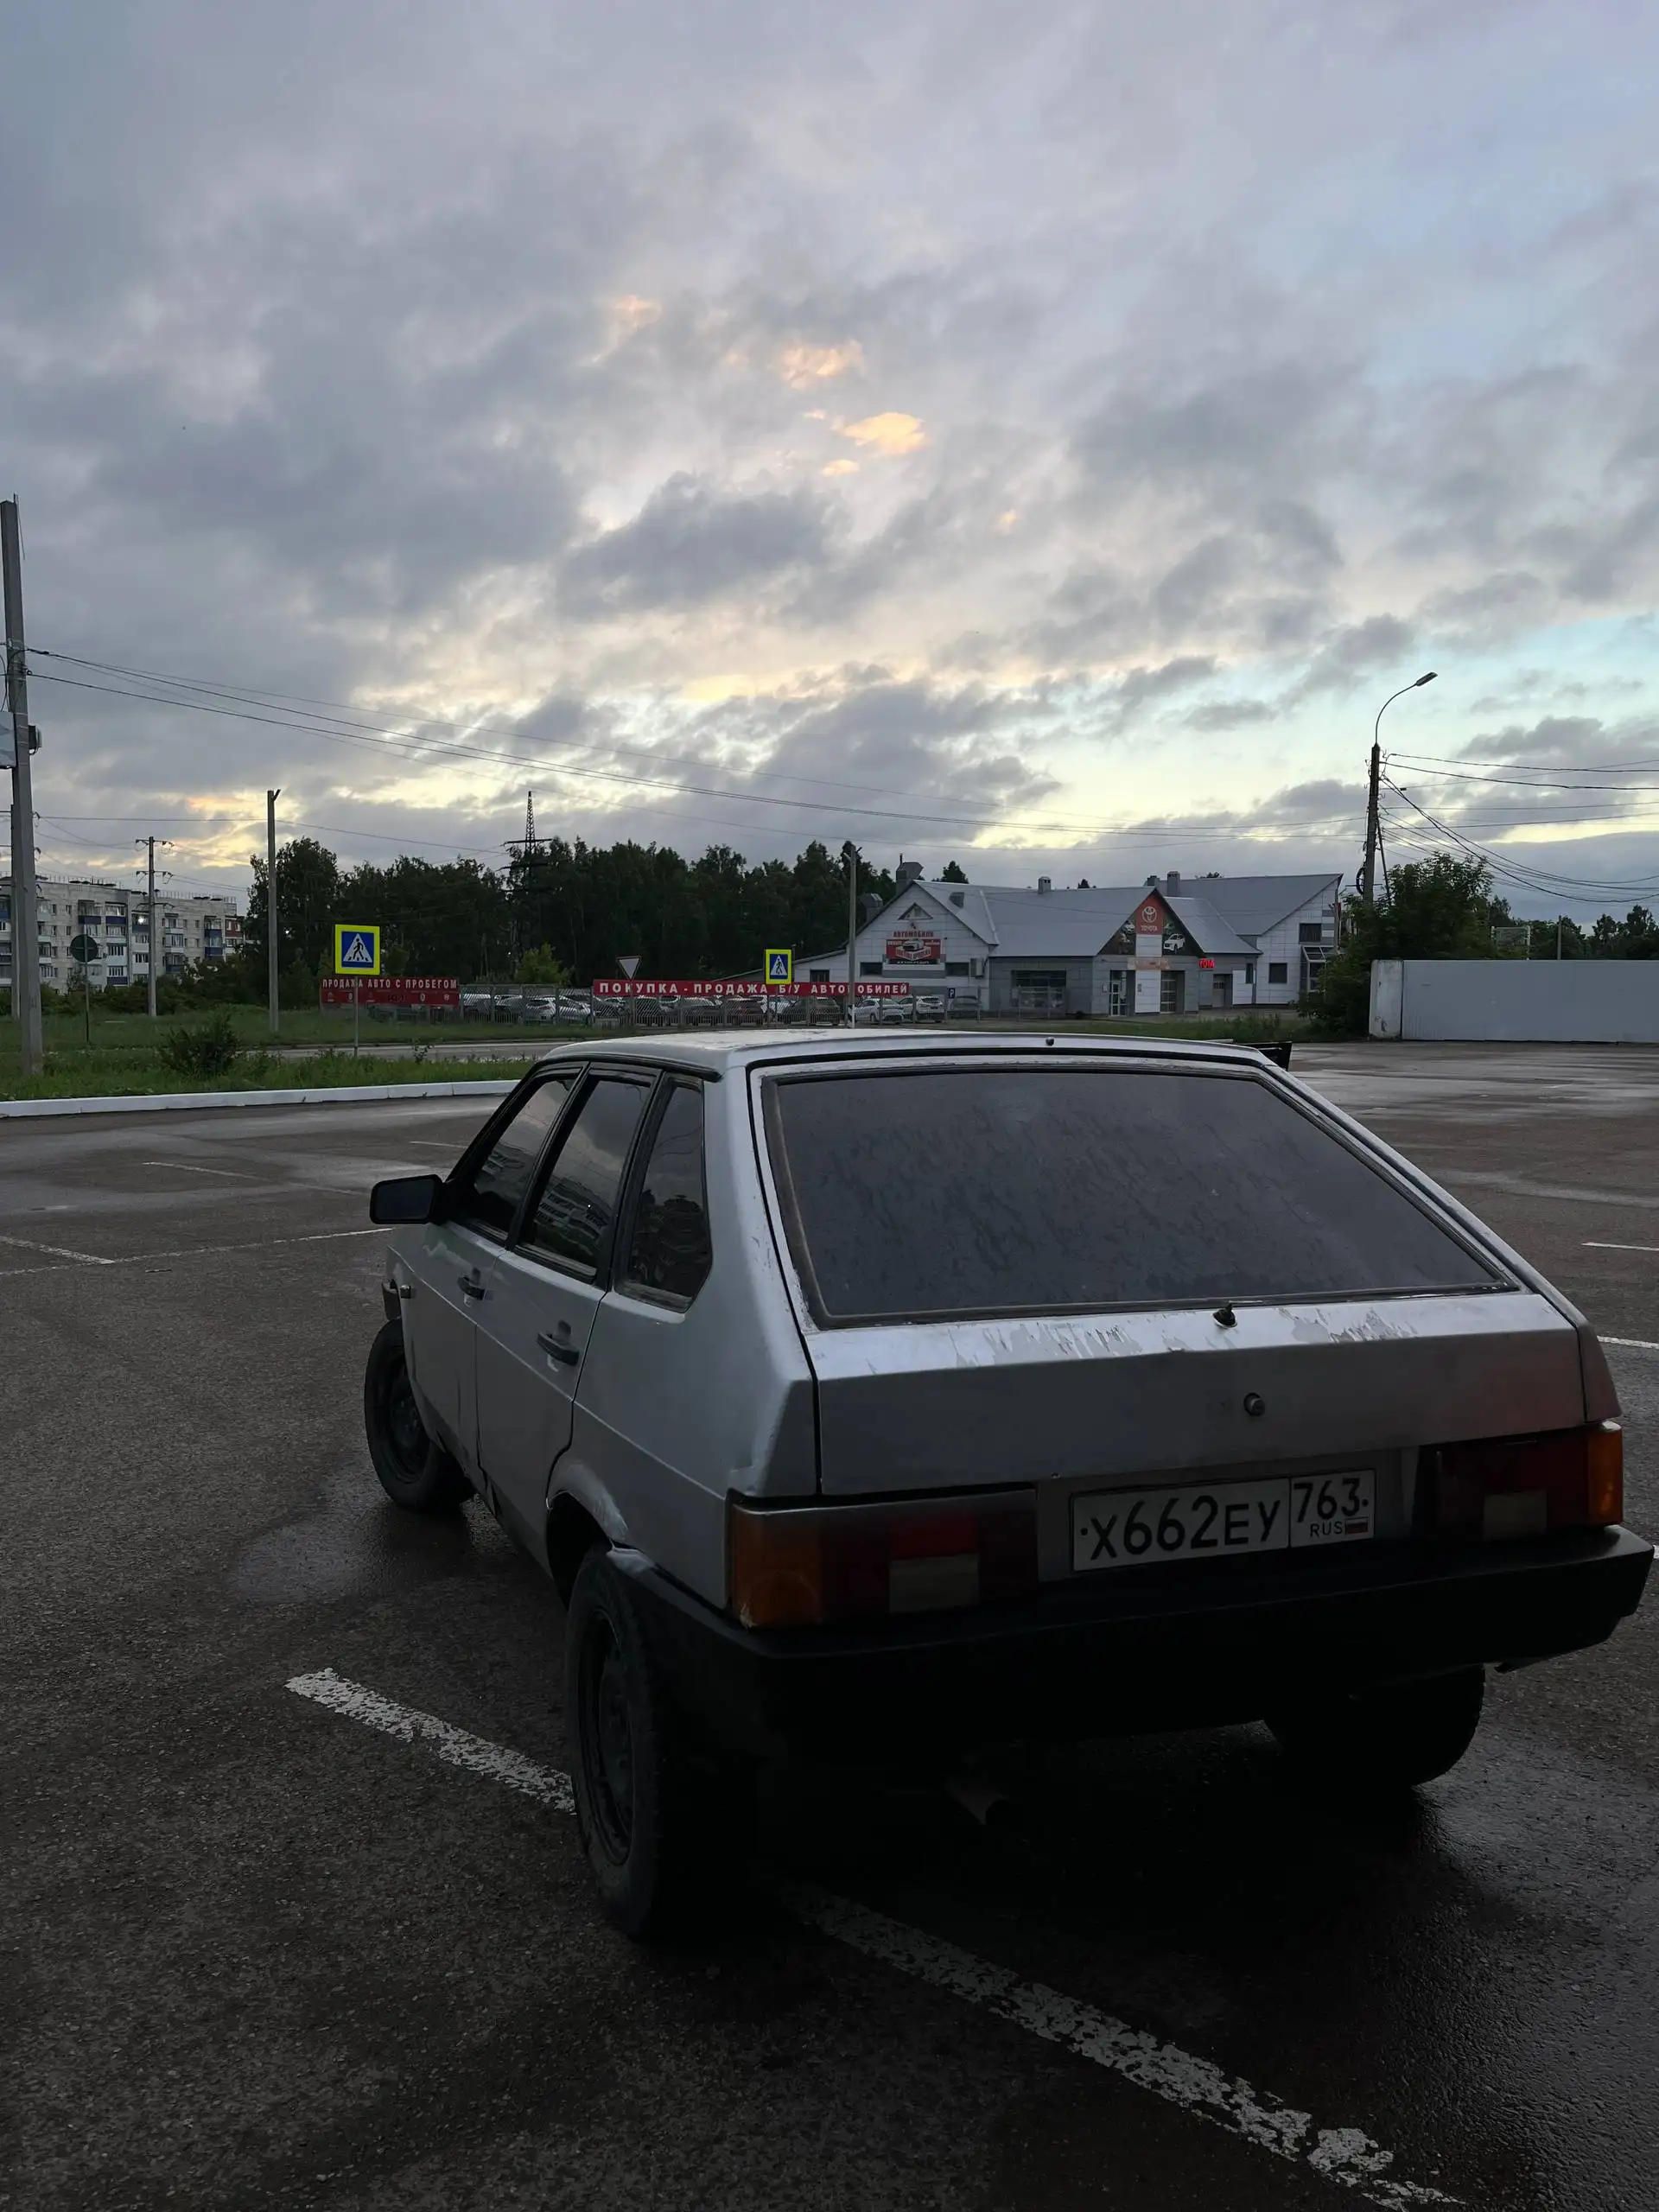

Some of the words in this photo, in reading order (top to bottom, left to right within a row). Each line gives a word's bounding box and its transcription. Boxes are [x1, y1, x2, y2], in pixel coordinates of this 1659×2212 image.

[323, 978, 363, 988] ПРОДАЖА
[367, 978, 391, 988] АВТО
[395, 978, 402, 988] С
[405, 978, 457, 988] ПРОБЕГОМ
[600, 982, 678, 993] ПОКУПКА
[694, 983, 767, 995] ПРОДАЖА
[779, 983, 800, 994] Б/У
[810, 983, 907, 994] АВТООБИЛЕЙ
[1293, 1478, 1360, 1523] 763
[1090, 1494, 1281, 1560] Х662ЕУ
[1309, 1521, 1344, 1538] RUS
